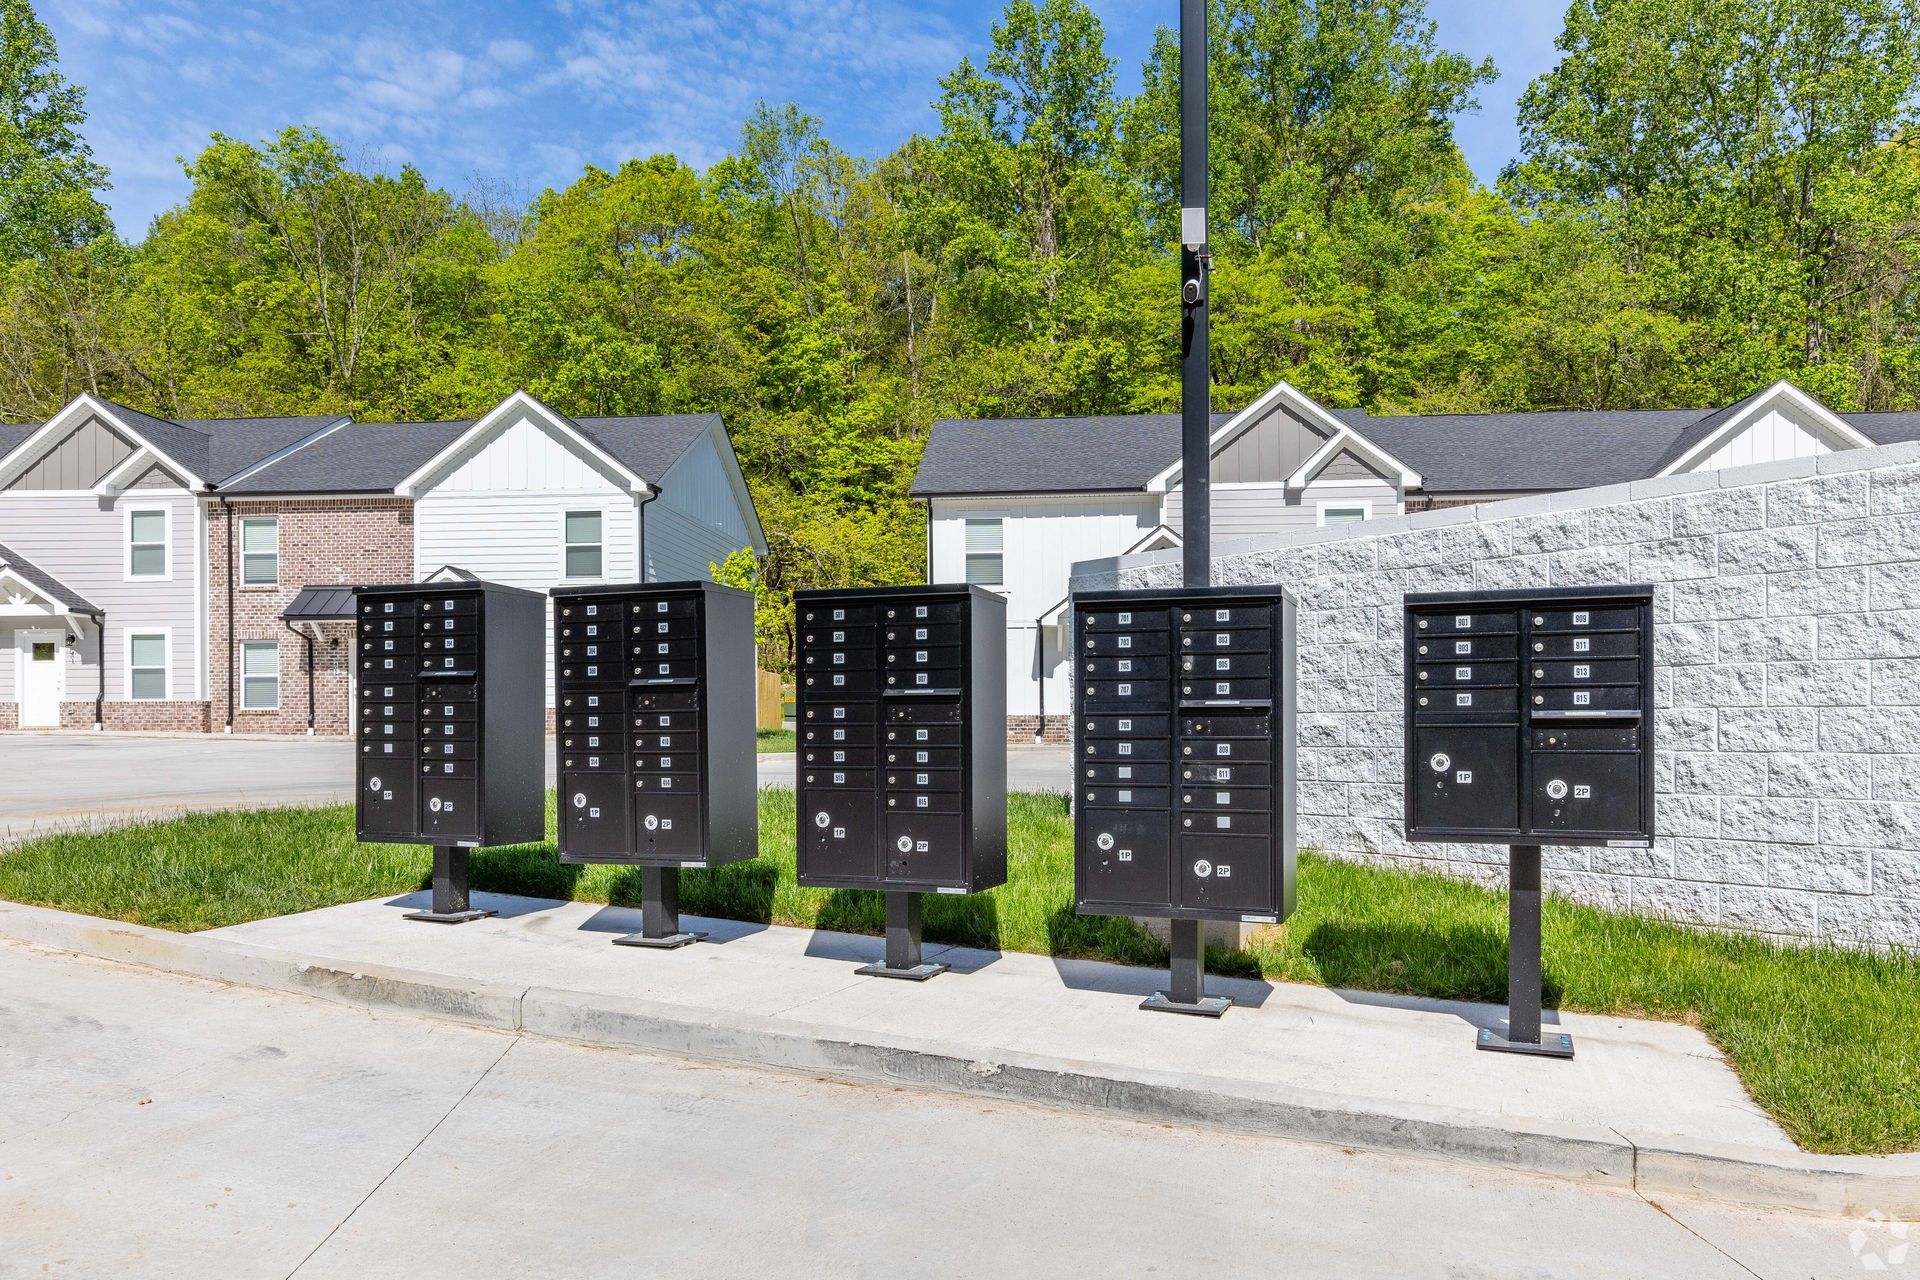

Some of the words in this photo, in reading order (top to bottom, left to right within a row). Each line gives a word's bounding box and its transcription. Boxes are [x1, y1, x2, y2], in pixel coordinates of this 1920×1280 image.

[1120, 614, 1129, 622] 701
[1218, 611, 1228, 620] 801
[1575, 614, 1587, 623] 909
[1458, 617, 1469, 626] 901
[1120, 638, 1129, 646] 703
[1576, 640, 1587, 650] 911
[1458, 643, 1469, 652] 903
[1458, 669, 1469, 678] 905
[1576, 667, 1588, 676] 913
[1120, 686, 1129, 694] 707
[1218, 684, 1228, 693] 807
[1459, 695, 1469, 704] 907
[1576, 694, 1588, 703] 915
[1120, 745, 1129, 753] 711
[1218, 770, 1228, 778] 811
[1458, 773, 1470, 781] 1P
[1576, 788, 1589, 796] 2P
